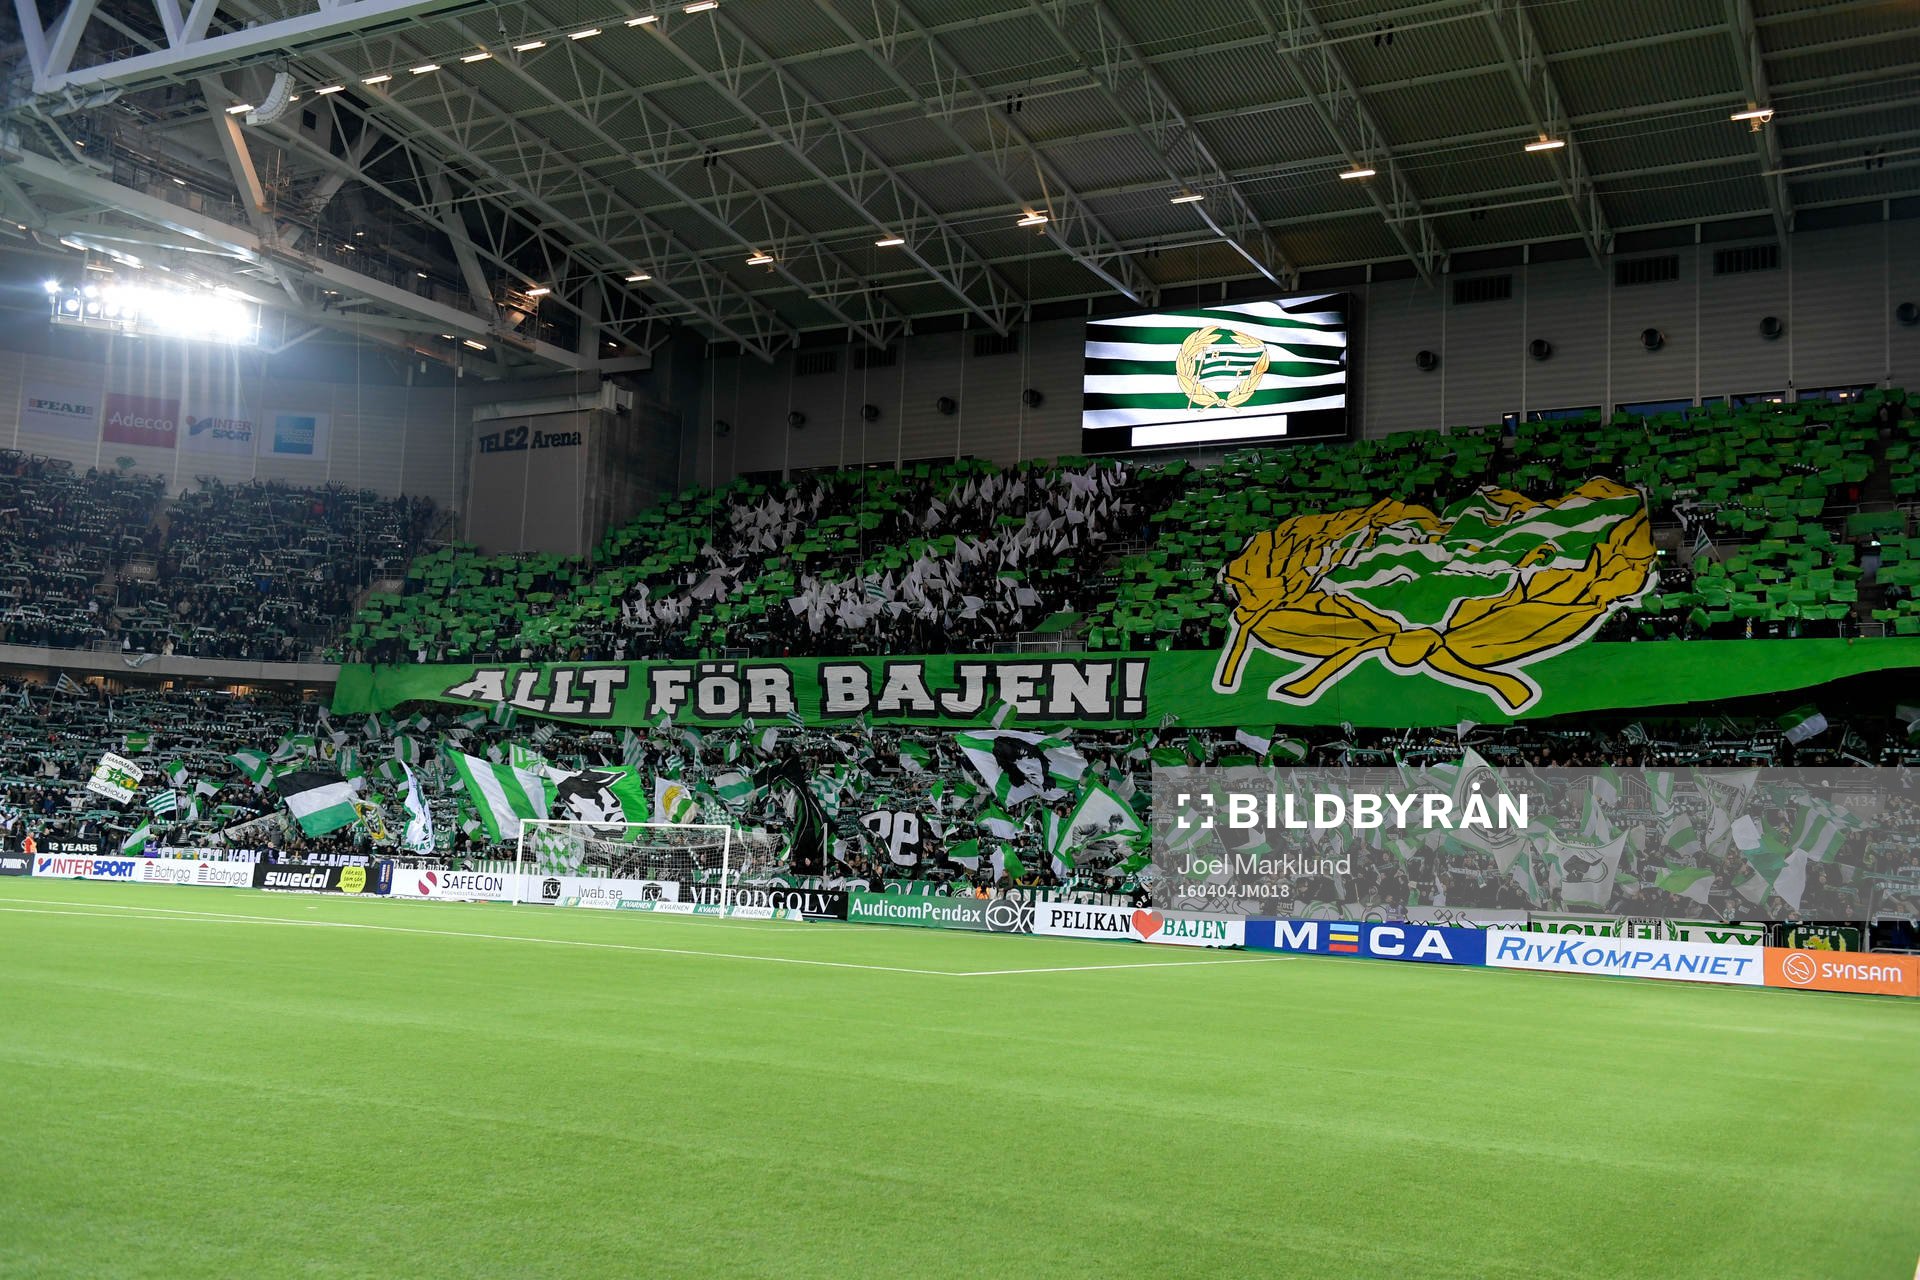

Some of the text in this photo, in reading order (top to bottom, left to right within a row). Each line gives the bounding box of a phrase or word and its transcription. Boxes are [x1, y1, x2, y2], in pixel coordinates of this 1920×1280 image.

[109, 411, 174, 432] Adecco
[213, 416, 252, 431] INTER
[212, 430, 251, 442] SPORT
[480, 426, 582, 453] TELE2 Arena
[446, 661, 1148, 716] ALLT FÖR BAJEN!
[48, 842, 98, 852] 12 YEARS
[52, 858, 136, 877] INTERSPORT
[154, 865, 191, 882] Botrygg
[209, 867, 249, 885] Botrygg
[264, 868, 331, 889] swedol
[659, 901, 690, 911] KVARNEN
[851, 898, 981, 923] AudicomPendax
[1051, 910, 1227, 940] PELIKAN BAJEN
[1274, 920, 1453, 960] MECA
[1822, 963, 1902, 983] SYNSAM
